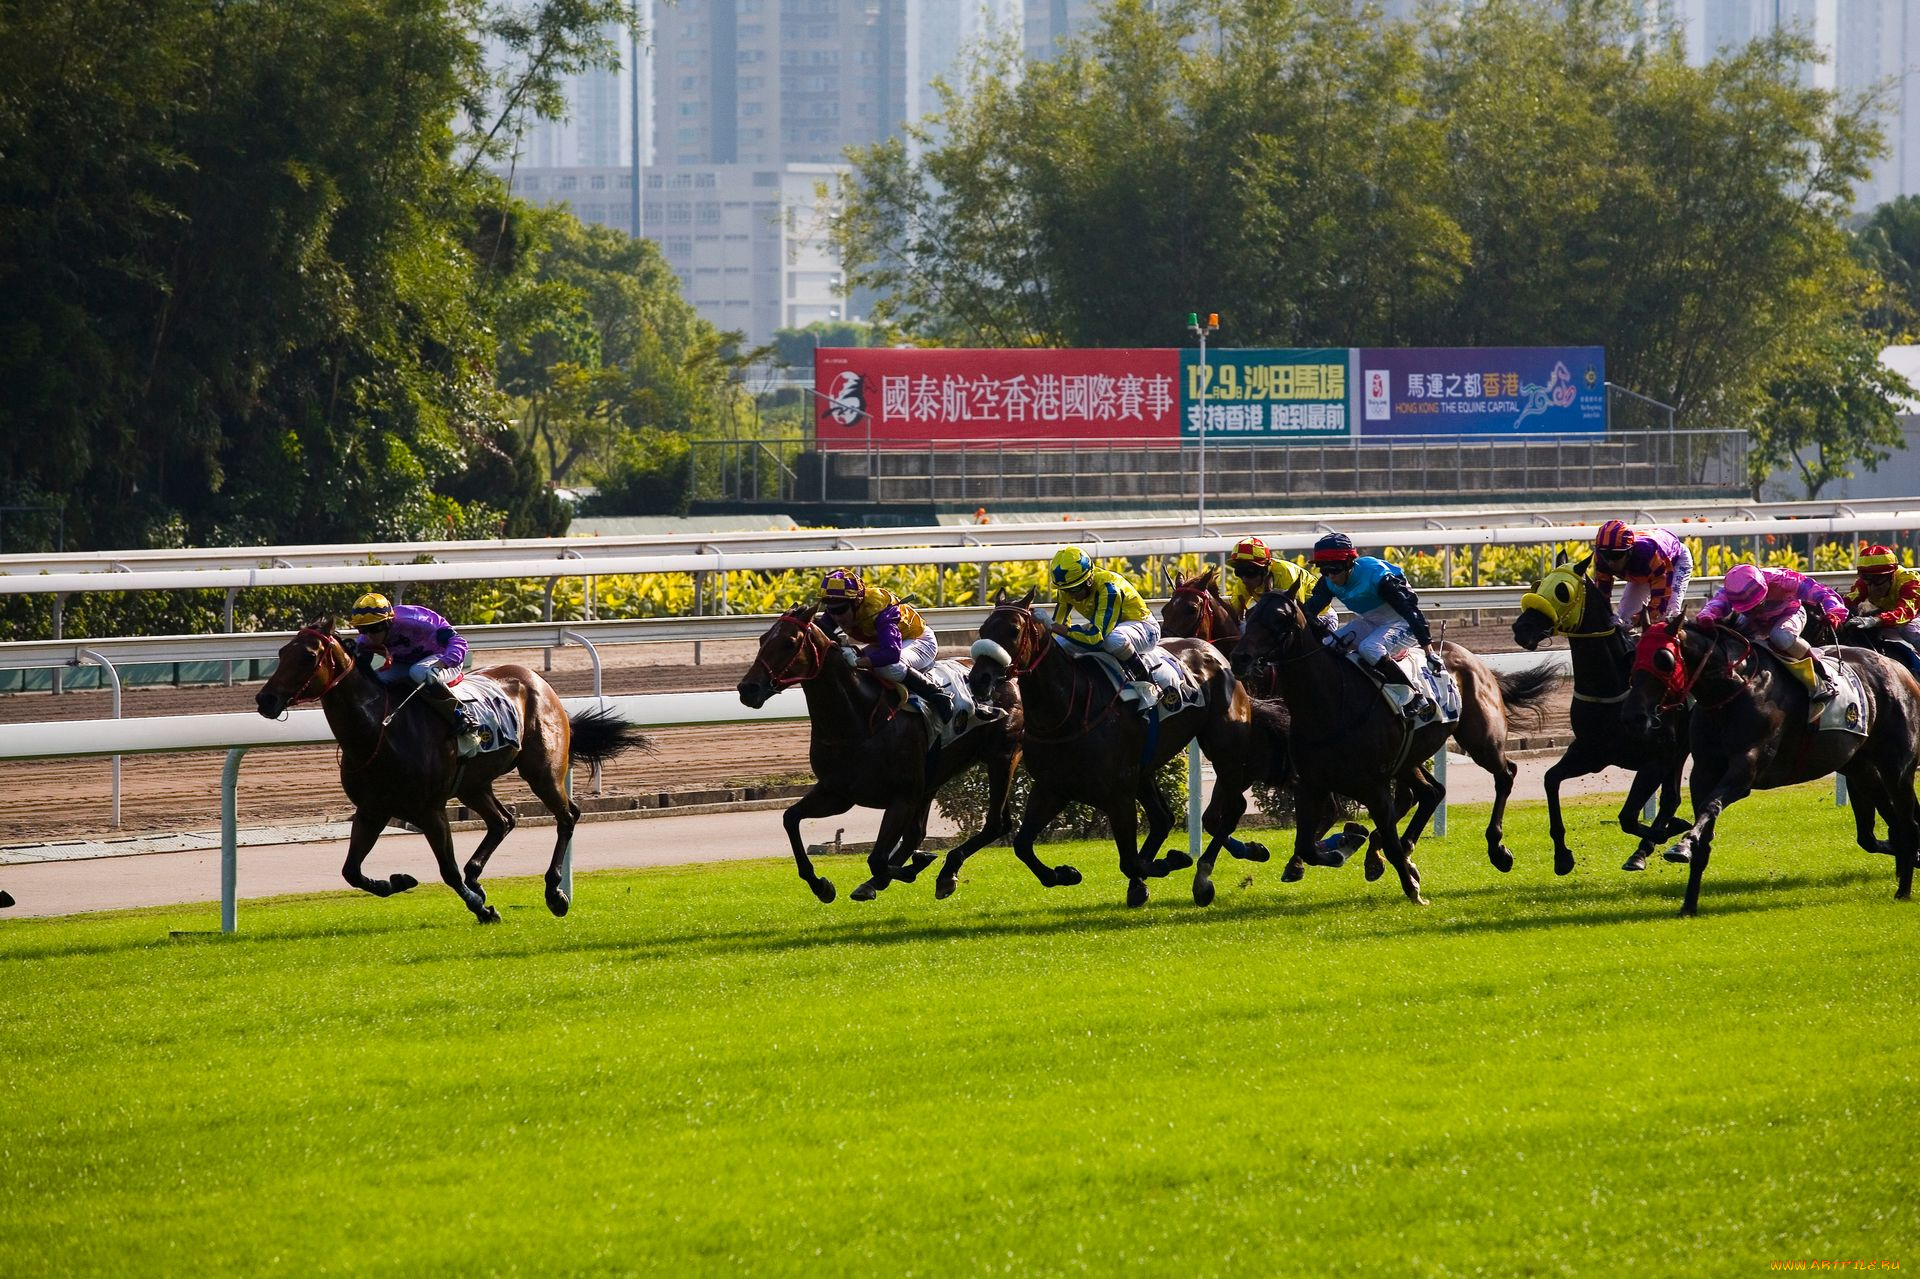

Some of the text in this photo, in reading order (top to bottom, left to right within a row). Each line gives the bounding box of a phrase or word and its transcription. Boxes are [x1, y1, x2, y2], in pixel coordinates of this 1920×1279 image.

[881, 374, 1174, 422] 國泰航空香港國際賽事
[1408, 373, 1519, 398] 馬運之都香港
[1187, 403, 1345, 431] 支持香港 跑到最前
[1396, 403, 1417, 413] HONG
[1419, 403, 1439, 413] KONG
[1441, 402, 1456, 413] THE
[1459, 402, 1485, 413] EQUINE
[1488, 401, 1519, 412] CAPITAL
